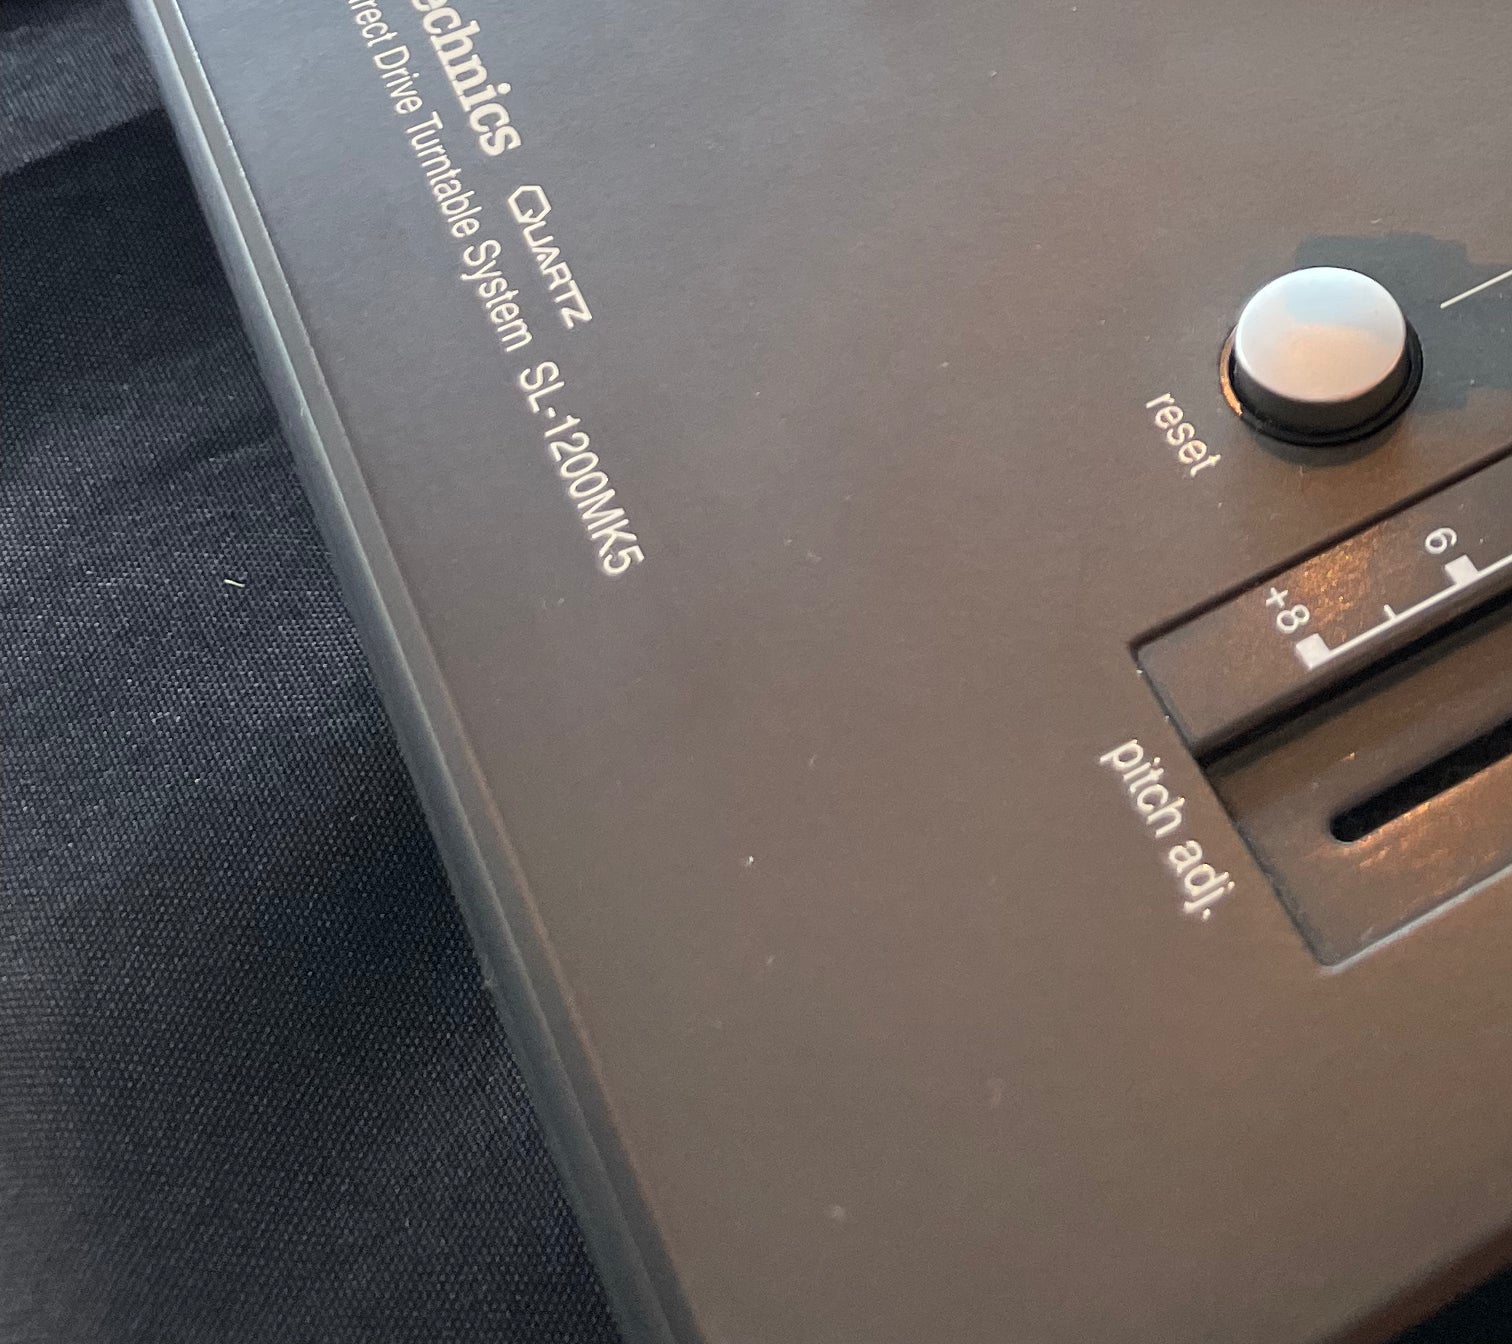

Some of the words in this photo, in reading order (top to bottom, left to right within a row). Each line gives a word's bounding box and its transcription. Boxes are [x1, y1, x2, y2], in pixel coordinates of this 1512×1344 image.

[372, 44, 424, 115] Drive
[404, 110, 483, 239] Turntable
[459, 239, 533, 353] System
[519, 361, 645, 576] SL-1200MK5
[507, 185, 593, 330] QUARTZ
[1145, 392, 1222, 479] reset
[1424, 527, 1458, 555] 6
[1265, 587, 1311, 635] +8
[1099, 738, 1186, 839] pitch
[1167, 839, 1236, 921] adj.
